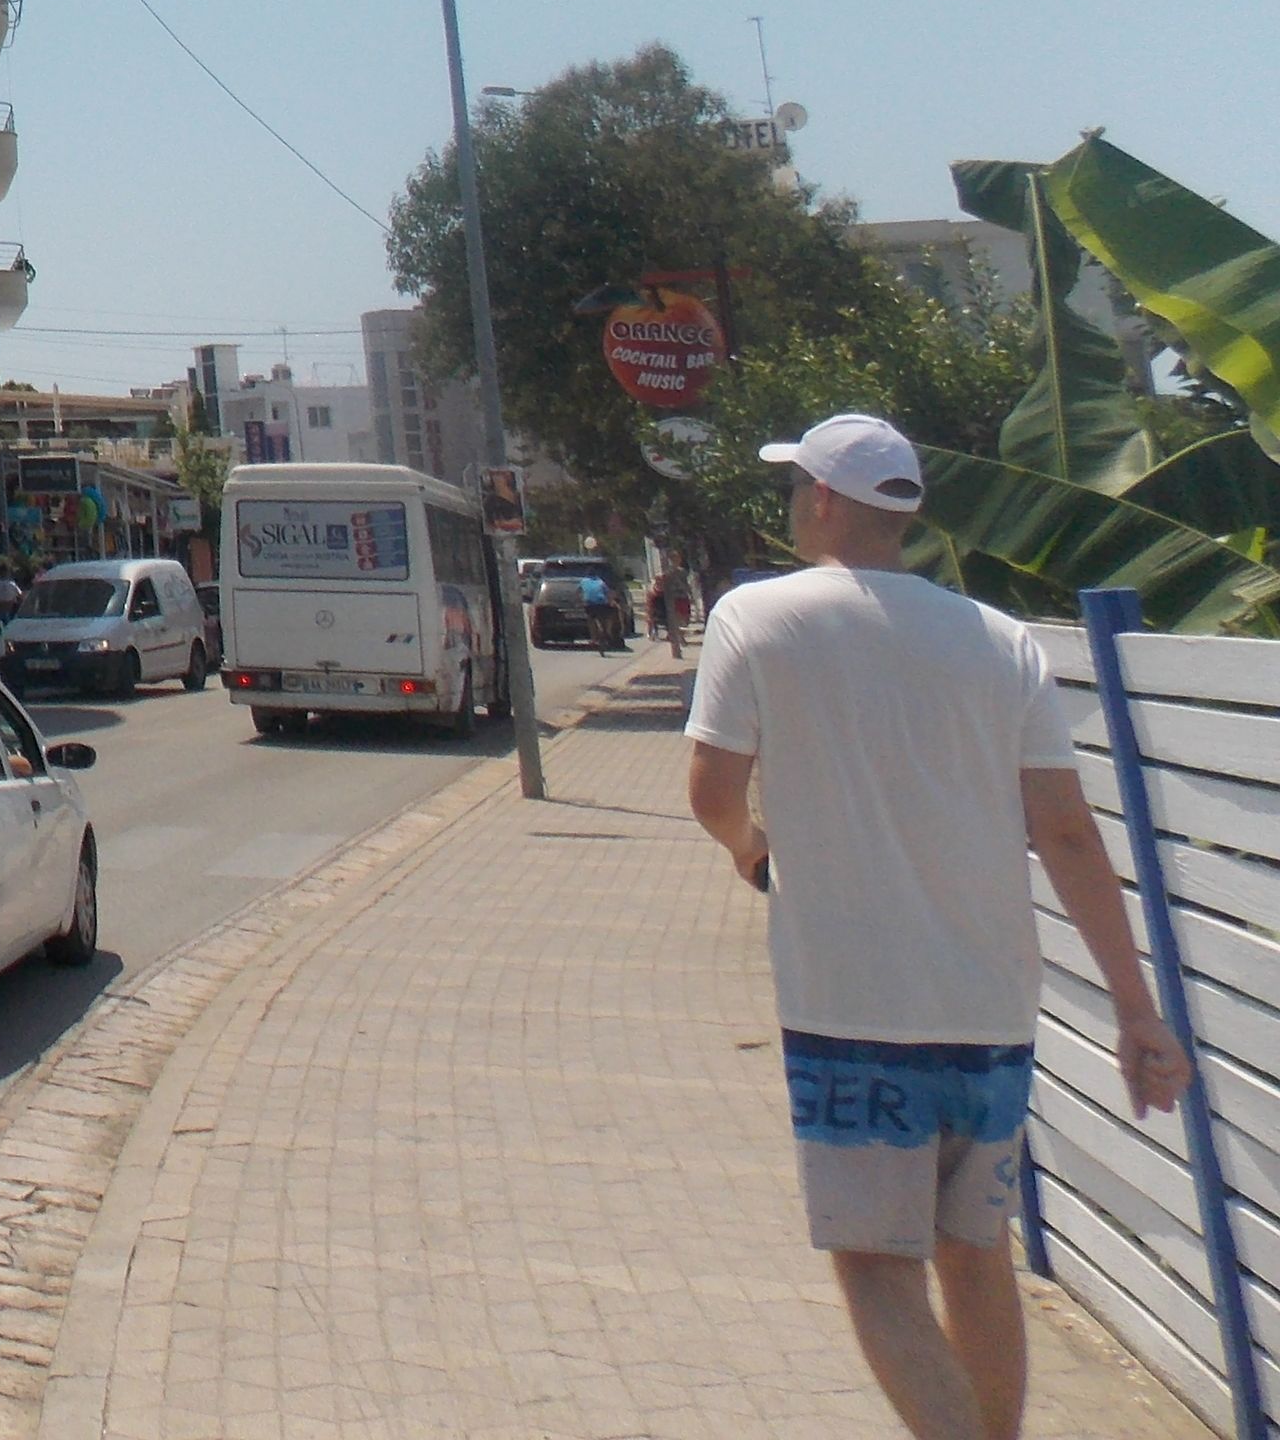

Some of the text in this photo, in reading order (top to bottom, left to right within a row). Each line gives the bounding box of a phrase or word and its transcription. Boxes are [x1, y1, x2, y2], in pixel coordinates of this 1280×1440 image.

[610, 321, 714, 347] ORANGE
[611, 345, 715, 369] COCKTAIL BAR
[637, 371, 686, 391] MUSIC
[261, 523, 326, 546] SIGAL
